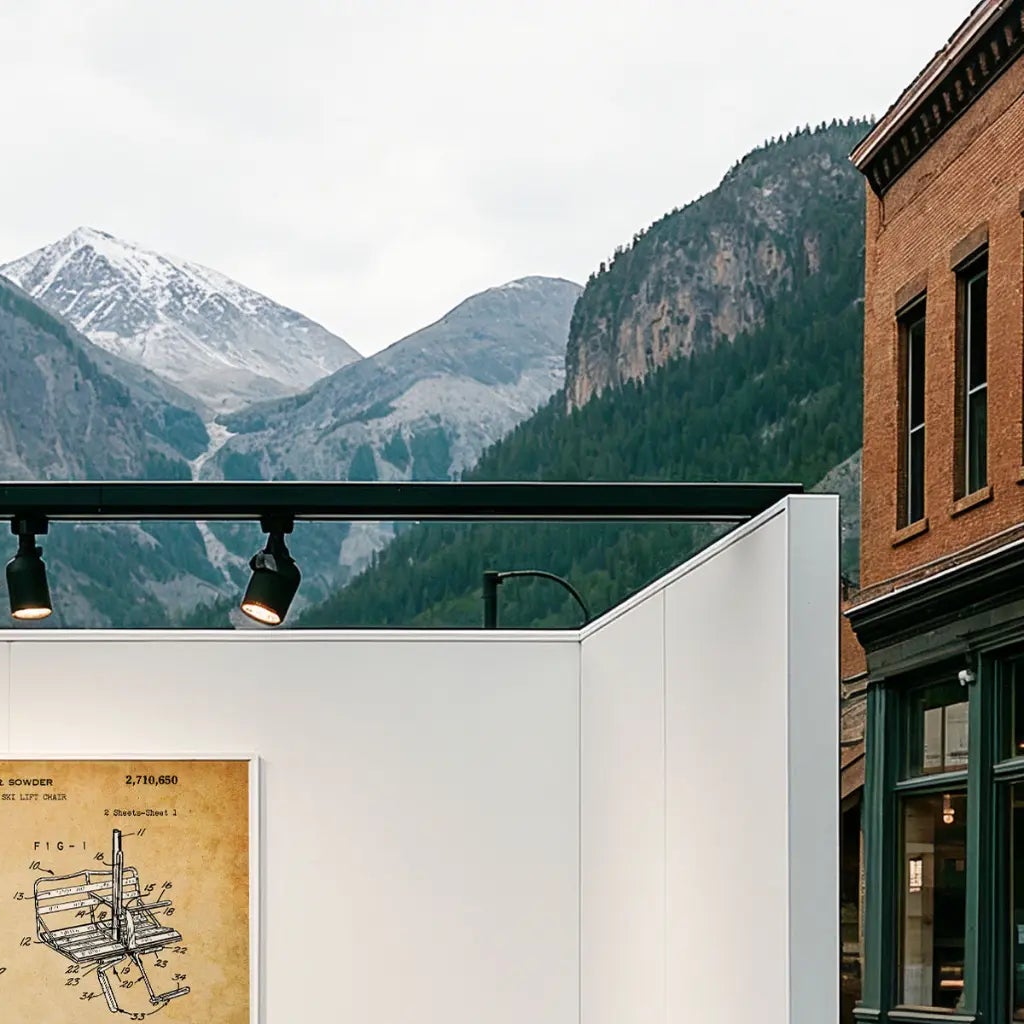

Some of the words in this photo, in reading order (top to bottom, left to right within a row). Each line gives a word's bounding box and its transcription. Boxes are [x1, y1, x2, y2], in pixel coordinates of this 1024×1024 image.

[125, 775, 178, 786] 2,710,650
[113, 809, 168, 817] Sheets-Sheet
[137, 828, 146, 837] 11
[93, 852, 105, 861] 16
[29, 861, 41, 870] 10
[144, 883, 156, 892] 15
[161, 881, 173, 889] 16
[13, 891, 24, 900] 13
[19, 936, 31, 946] 12
[172, 946, 188, 955] 22
[154, 959, 169, 968] 23
[65, 965, 80, 974] 22
[65, 977, 81, 986] 23
[172, 973, 187, 981] 34
[119, 980, 134, 989] 20
[79, 991, 94, 1001] 34
[130, 1013, 146, 1021] 33
